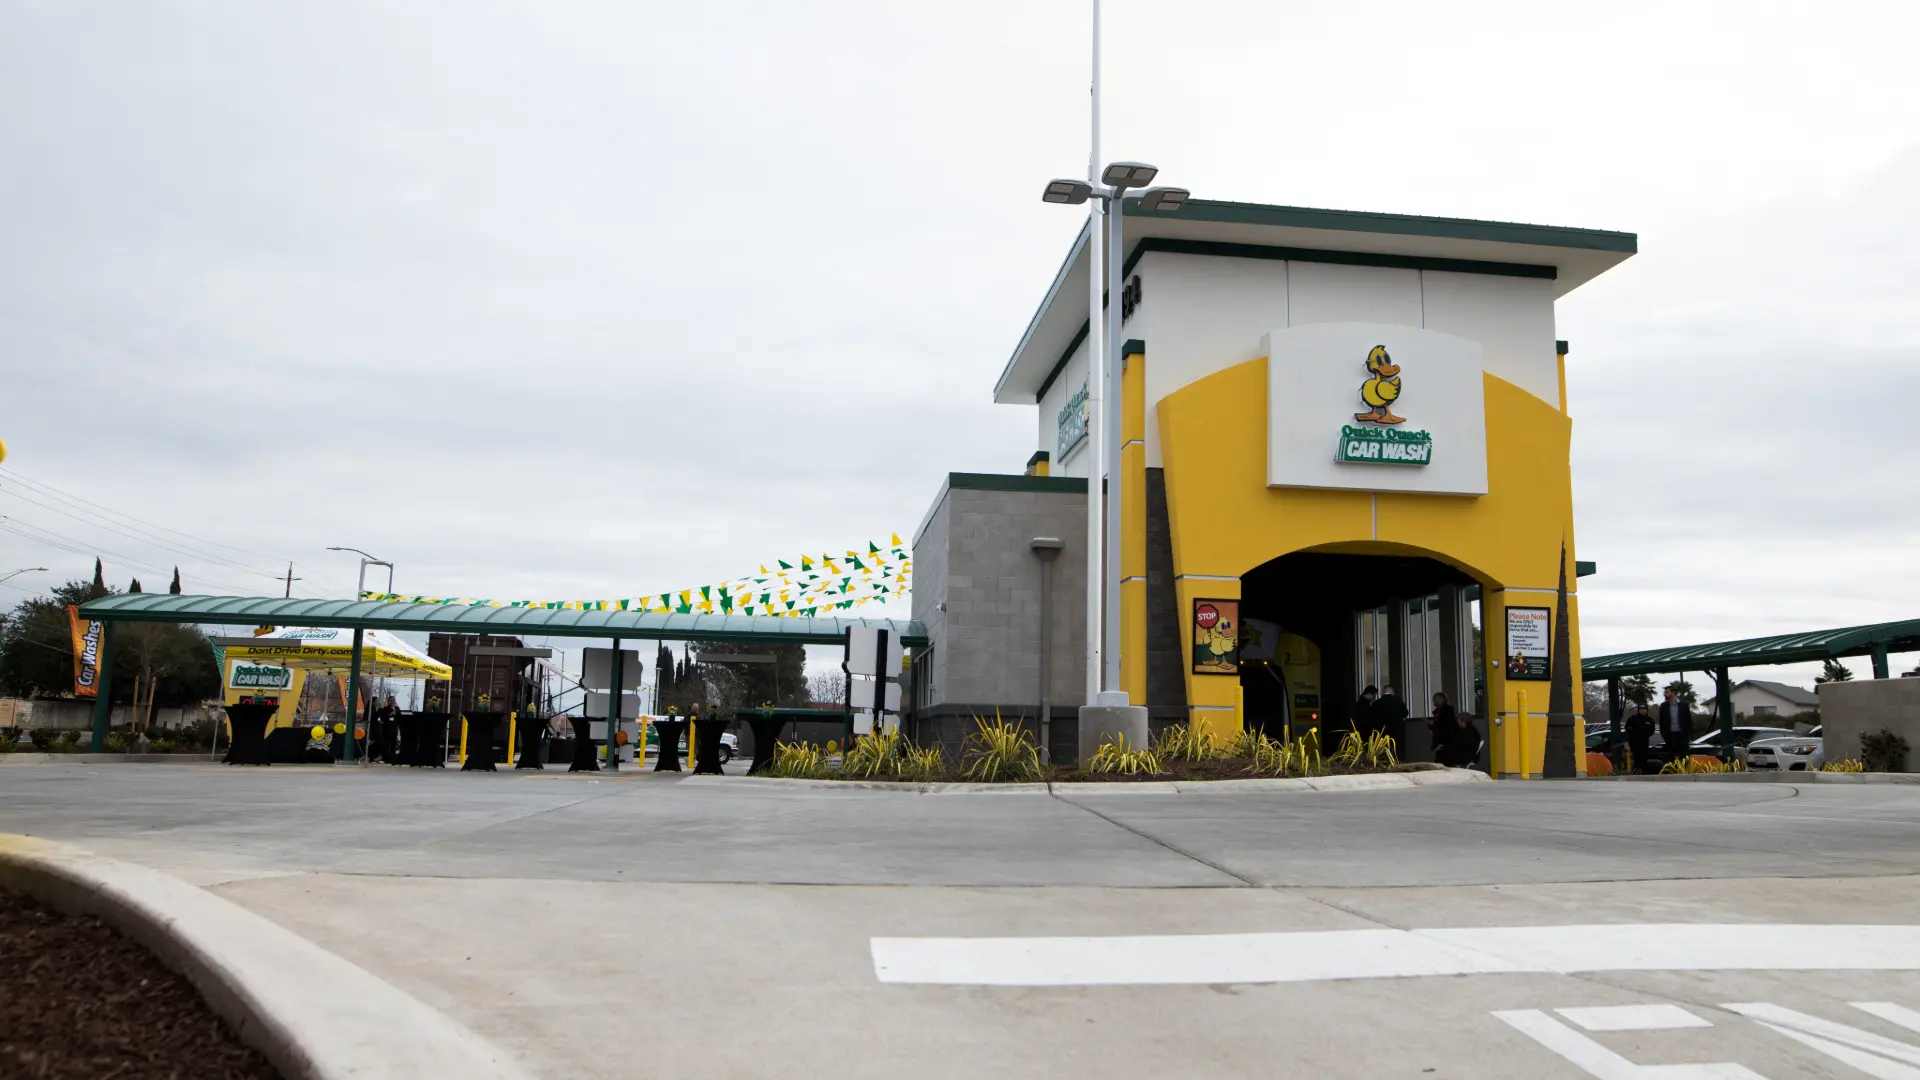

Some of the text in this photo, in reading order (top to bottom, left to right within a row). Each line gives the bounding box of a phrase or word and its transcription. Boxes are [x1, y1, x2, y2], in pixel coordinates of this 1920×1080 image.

[1342, 425, 1431, 441] Quick Quack
[1347, 441, 1428, 461] CAR WASH
[1198, 612, 1216, 621] STOP
[78, 619, 101, 686] Car Washes
[237, 674, 257, 685] CAR
